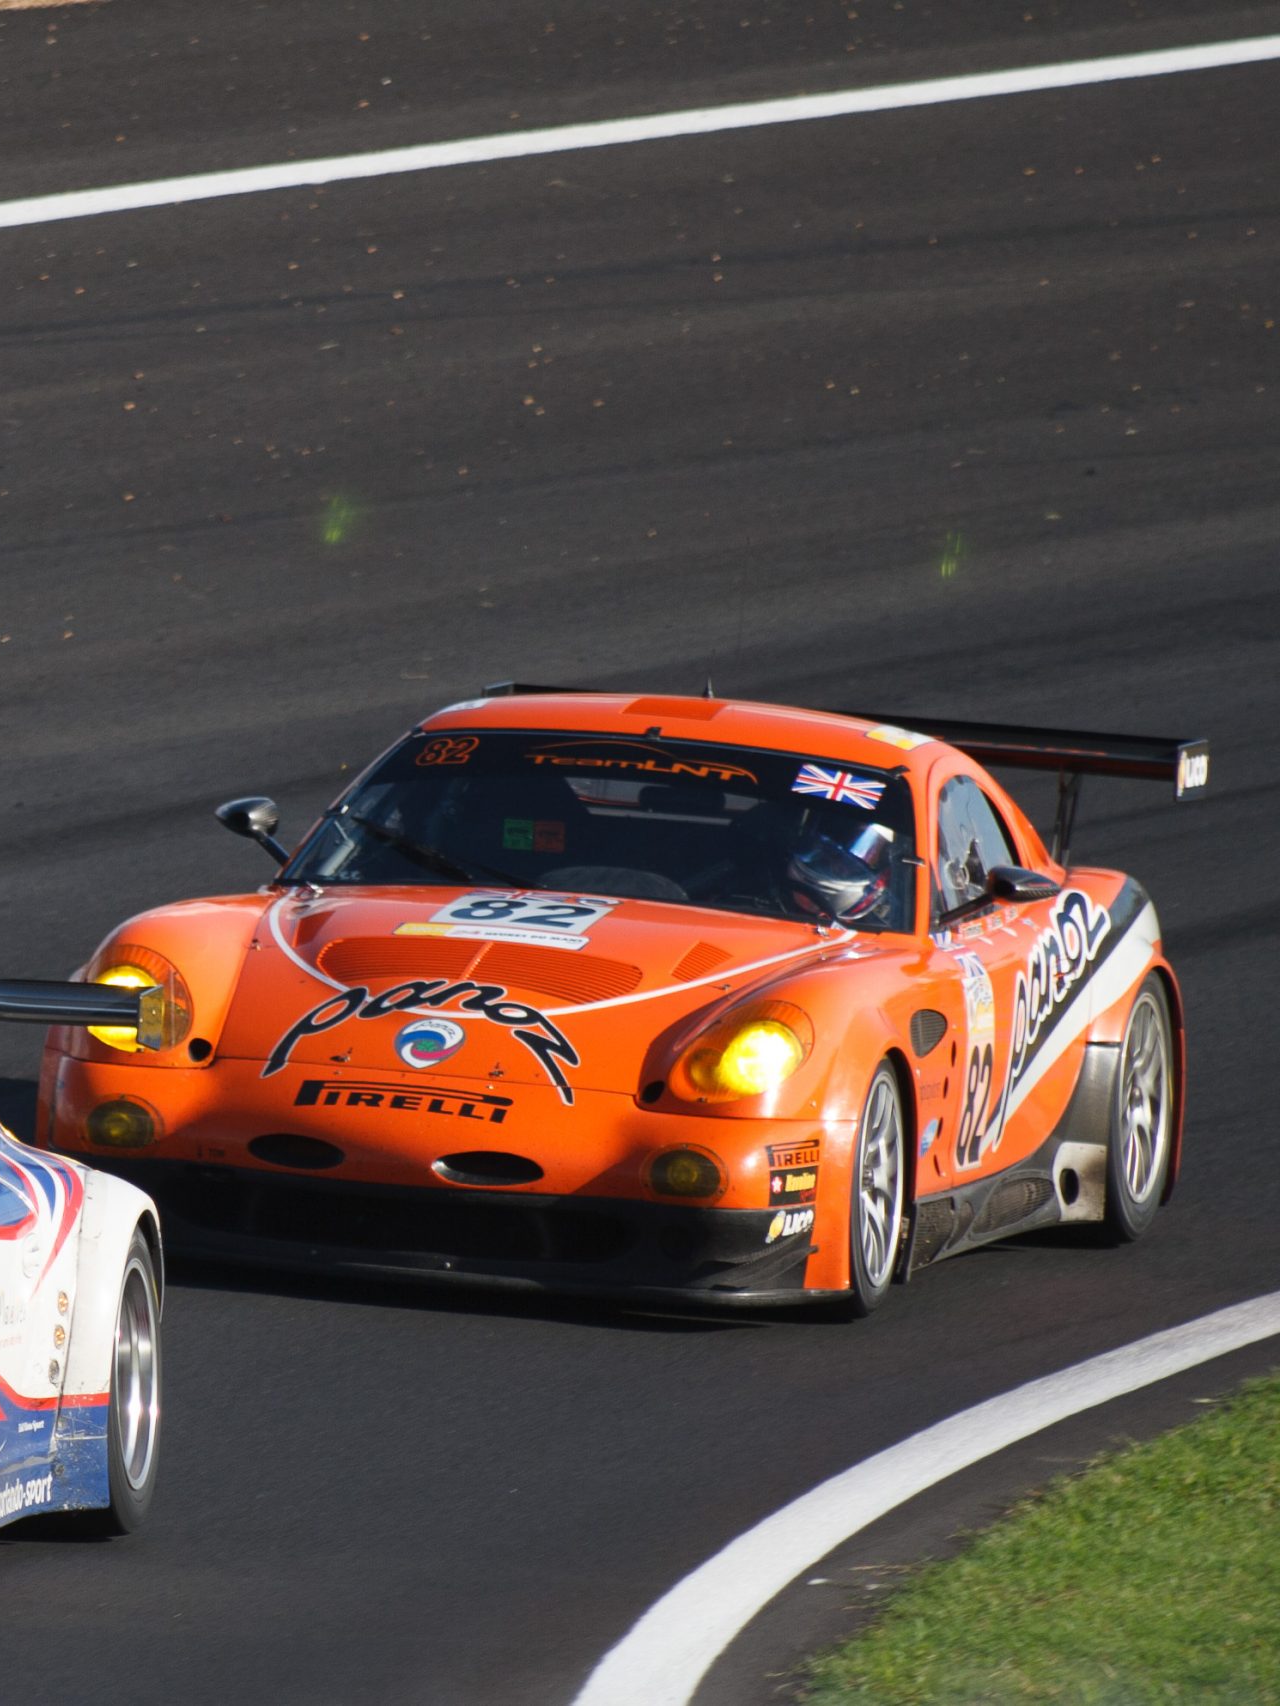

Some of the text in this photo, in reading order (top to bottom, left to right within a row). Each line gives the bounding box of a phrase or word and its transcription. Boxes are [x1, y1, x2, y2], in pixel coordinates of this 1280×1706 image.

[416, 737, 479, 766] 82
[450, 900, 597, 928] 82
[260, 979, 579, 1106] panoz
[293, 1080, 514, 1124] PIRELLI
[956, 1043, 993, 1167] 82
[766, 1139, 820, 1168] PIRELLI
